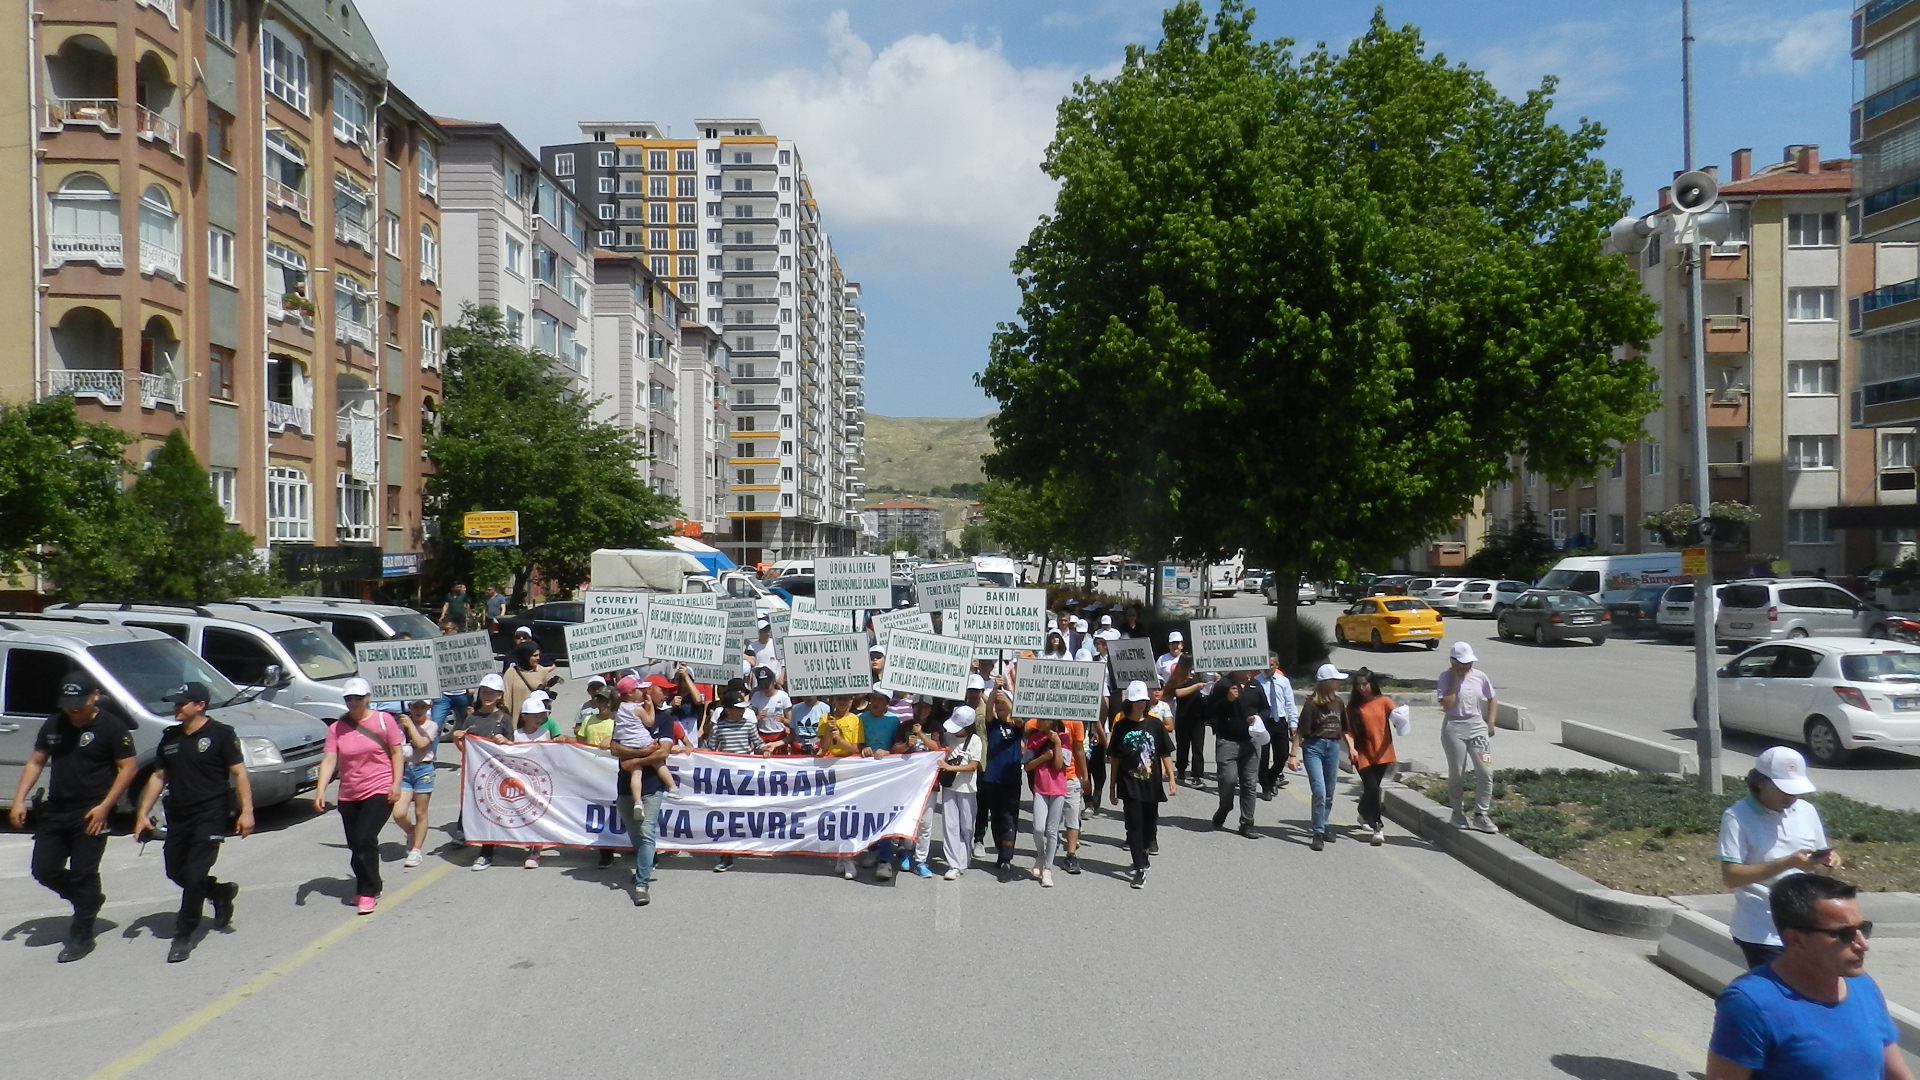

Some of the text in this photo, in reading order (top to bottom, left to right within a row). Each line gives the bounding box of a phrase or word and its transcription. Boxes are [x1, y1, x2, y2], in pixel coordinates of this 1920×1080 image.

[829, 561, 876, 574] ÜRÜN ALIRKEN
[917, 566, 976, 583] GELECEK NESİLLERİMİZE
[817, 577, 889, 593] GERİ DÖNÜŞÜMLÜ OLMASINA
[926, 583, 942, 596] TEMİZ
[942, 583, 952, 595] BİR
[595, 594, 638, 605] ÇEVREYİ
[686, 594, 714, 606] KİRLİLİĞİ
[831, 592, 876, 607] DİKKAT EDELİM
[934, 598, 960, 609] BIRAKAL
[986, 591, 1020, 602] BAKIMI
[590, 607, 639, 616] KORUMAK
[650, 607, 660, 621] BİR
[660, 610, 671, 622] CAM
[671, 609, 683, 626] ŞİŞE
[683, 610, 703, 626] DOĞADA
[966, 603, 1039, 617] DÜZENLİ OLARAK
[963, 619, 992, 630] YAPILAN
[993, 618, 1005, 631] BİR
[1006, 618, 1041, 632] OTOMOBİL
[1200, 622, 1258, 636] YERE TÜKÜREREK
[448, 635, 487, 649] KULLANILMIŞ
[569, 629, 644, 652] SİGARA İZMARİTİ ATMAYALIM
[650, 625, 672, 640] PLASTİK
[688, 631, 697, 644] YIL
[698, 631, 722, 646] SÜREYLE
[985, 634, 1002, 645] DAHA
[1003, 636, 1012, 645] AZ
[1013, 633, 1042, 646] KİRLETİR
[571, 649, 597, 663] PİKNİKTE
[598, 644, 629, 657] YAKTIĞIMIZ
[656, 643, 713, 661] YOK OLMAMAKTADIR
[793, 639, 818, 655] DÜNYA
[819, 636, 858, 653] YÜZEYİNİN
[947, 642, 970, 660] YAKLAŞIK
[1202, 638, 1258, 653] ÇOCUKLARIMIZA
[358, 649, 367, 663] SU
[367, 645, 391, 662] ZENGİNİ
[391, 645, 408, 661] ÜLKE
[438, 647, 480, 664] MOTOR YAĞI
[1116, 647, 1146, 661] KİRLETME
[1196, 655, 1268, 669] KÖTÜ ÖRNEK OLMAYALIM
[377, 664, 418, 680] SULARIMIZI
[470, 660, 493, 672] SUYUNU
[590, 656, 630, 672] SÖNDÜRELİM
[804, 655, 851, 674] %6'SI ÇÖL VE
[905, 655, 917, 670] GERİ
[916, 658, 946, 675] KAZANABİLİR
[946, 661, 967, 678] NİTELİKLİ
[1032, 662, 1090, 679] BİR TON KULLANILMIŞ
[391, 680, 428, 697] ETMEYELİM
[809, 674, 847, 694] ÇÖLLEŞMEK
[847, 673, 869, 688] ÜZERE
[890, 671, 960, 693] ATIKLAR OLUŞTURMAKTADIR
[1019, 677, 1099, 692] BEYAZ KAĞIT GERİ KAZANILDIĞINDA
[1022, 691, 1035, 701] ADET
[1035, 692, 1046, 704] ÇAM
[1045, 691, 1068, 703] AĞACININ
[1068, 694, 1099, 705] KESİLMEKTEN
[1015, 704, 1054, 716] KURTULDUĞUNU
[692, 765, 837, 797] HAZİRAN
[585, 800, 694, 839] DÜYA
[705, 810, 807, 842] ÇEVRE
